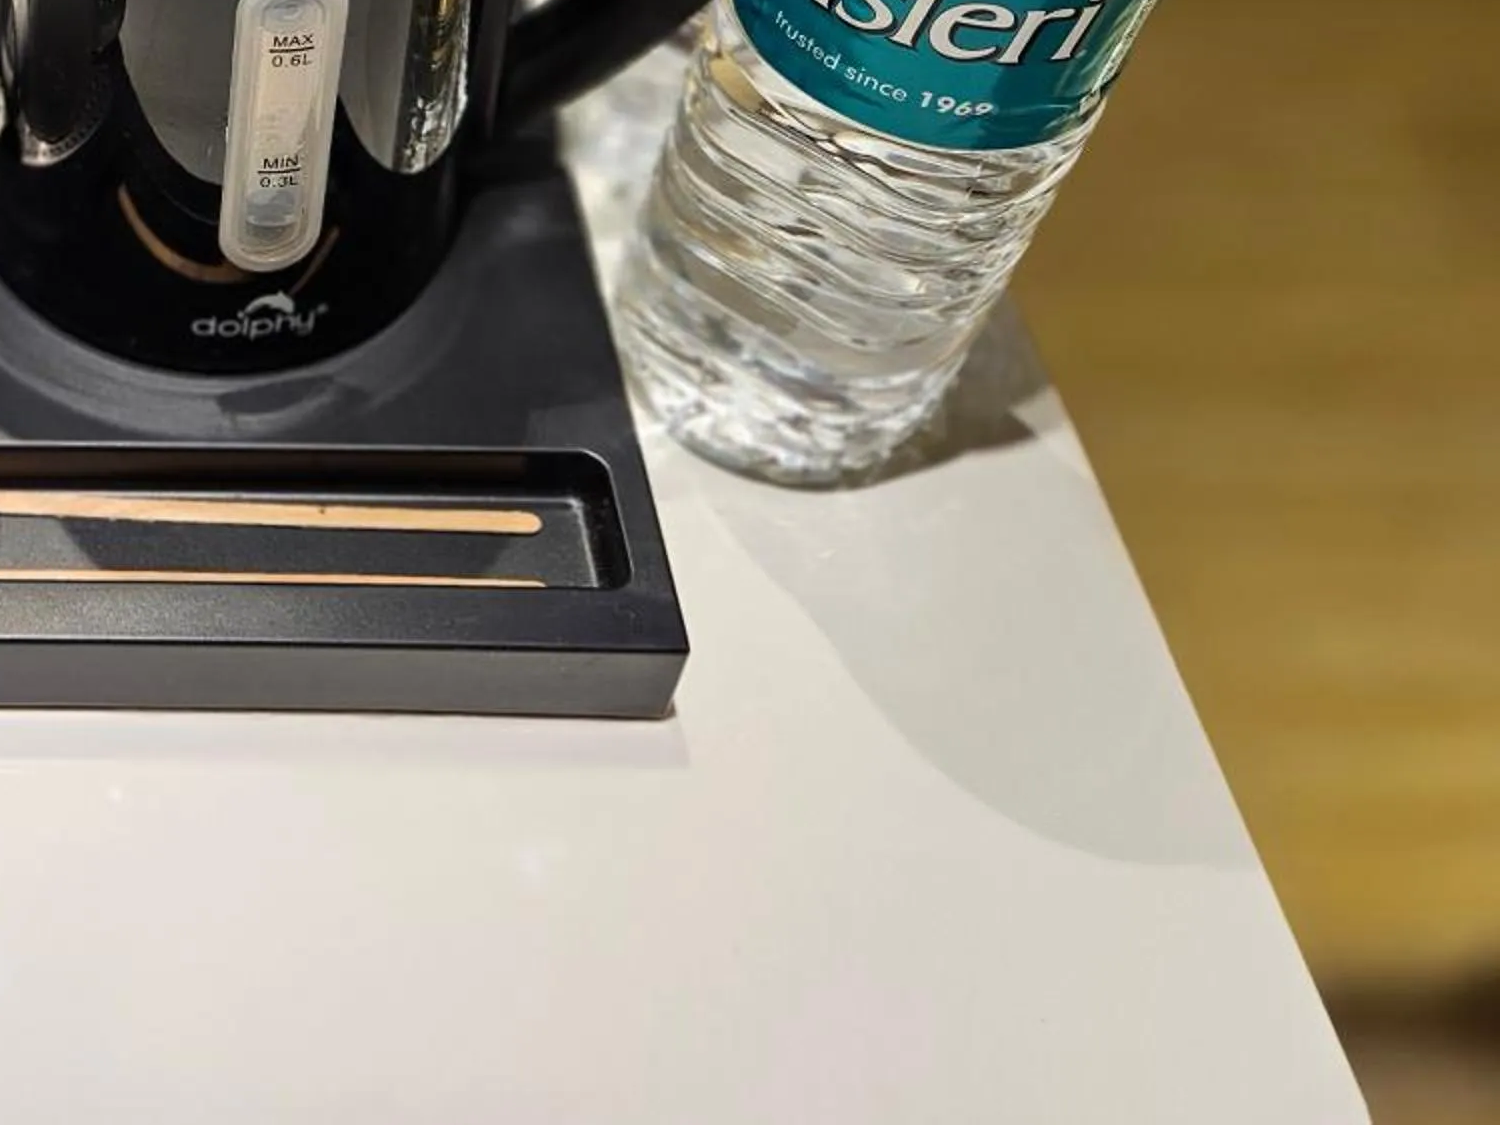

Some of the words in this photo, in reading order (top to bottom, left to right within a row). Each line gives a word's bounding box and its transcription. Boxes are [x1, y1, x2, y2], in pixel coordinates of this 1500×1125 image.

[272, 34, 315, 48] MAX
[271, 53, 313, 68] 0.6L
[775, 10, 842, 70] trusted
[843, 68, 908, 103] since
[920, 90, 995, 117] 1969
[263, 155, 300, 170] MIN
[259, 174, 299, 189] 0.3L
[191, 309, 316, 341] dolphy
